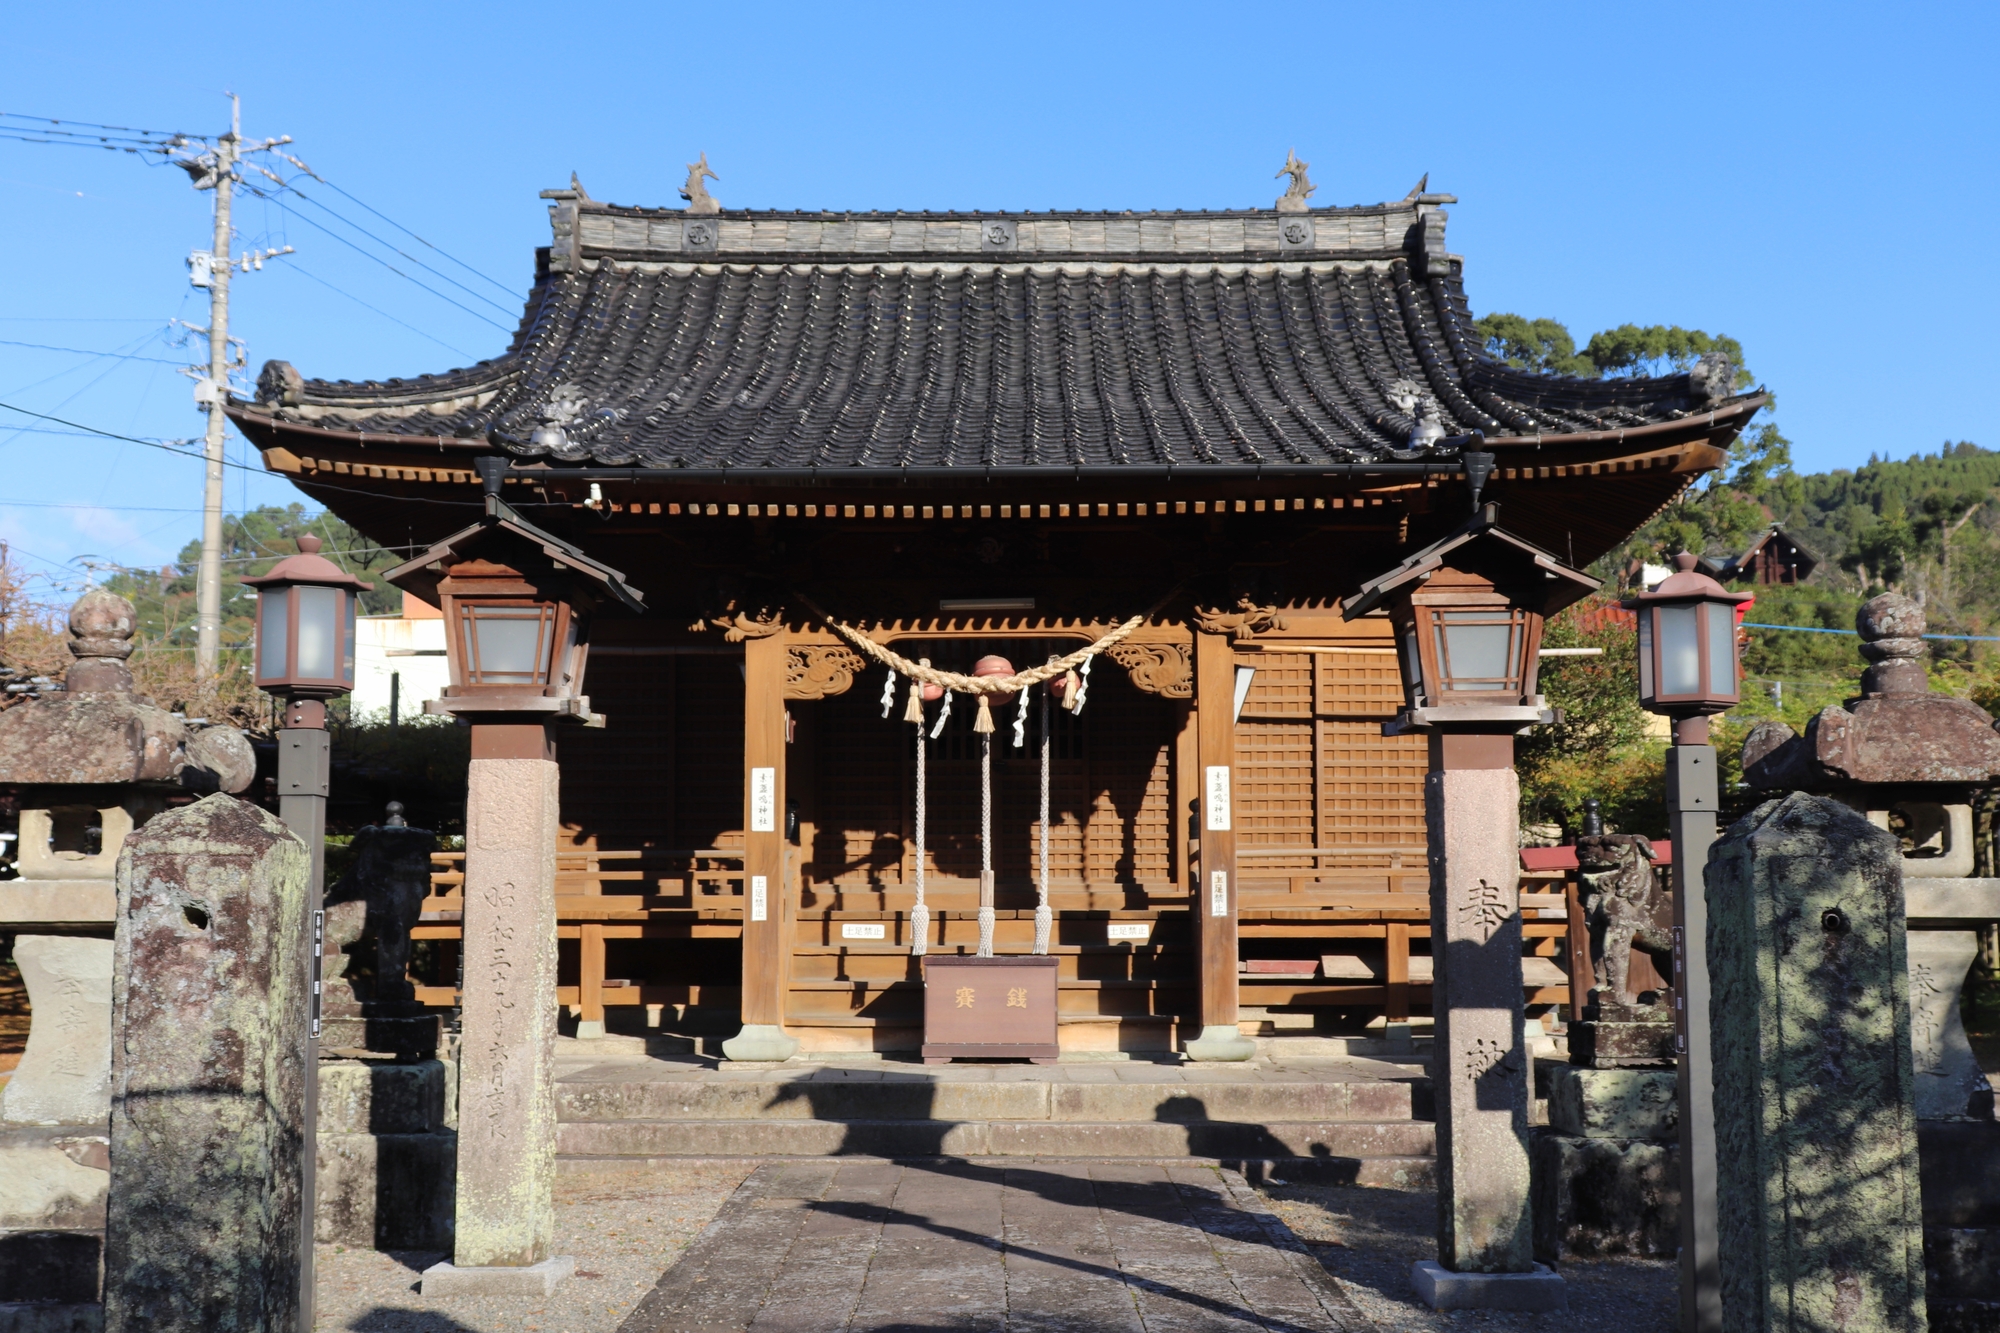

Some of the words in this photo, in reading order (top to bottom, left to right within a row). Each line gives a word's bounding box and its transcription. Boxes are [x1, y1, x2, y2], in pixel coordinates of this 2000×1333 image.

[754, 878, 765, 918] 土足禁止
[1213, 873, 1224, 914] 土足禁止
[844, 926, 882, 937] 土足禁止
[1109, 926, 1147, 936] 土足禁止
